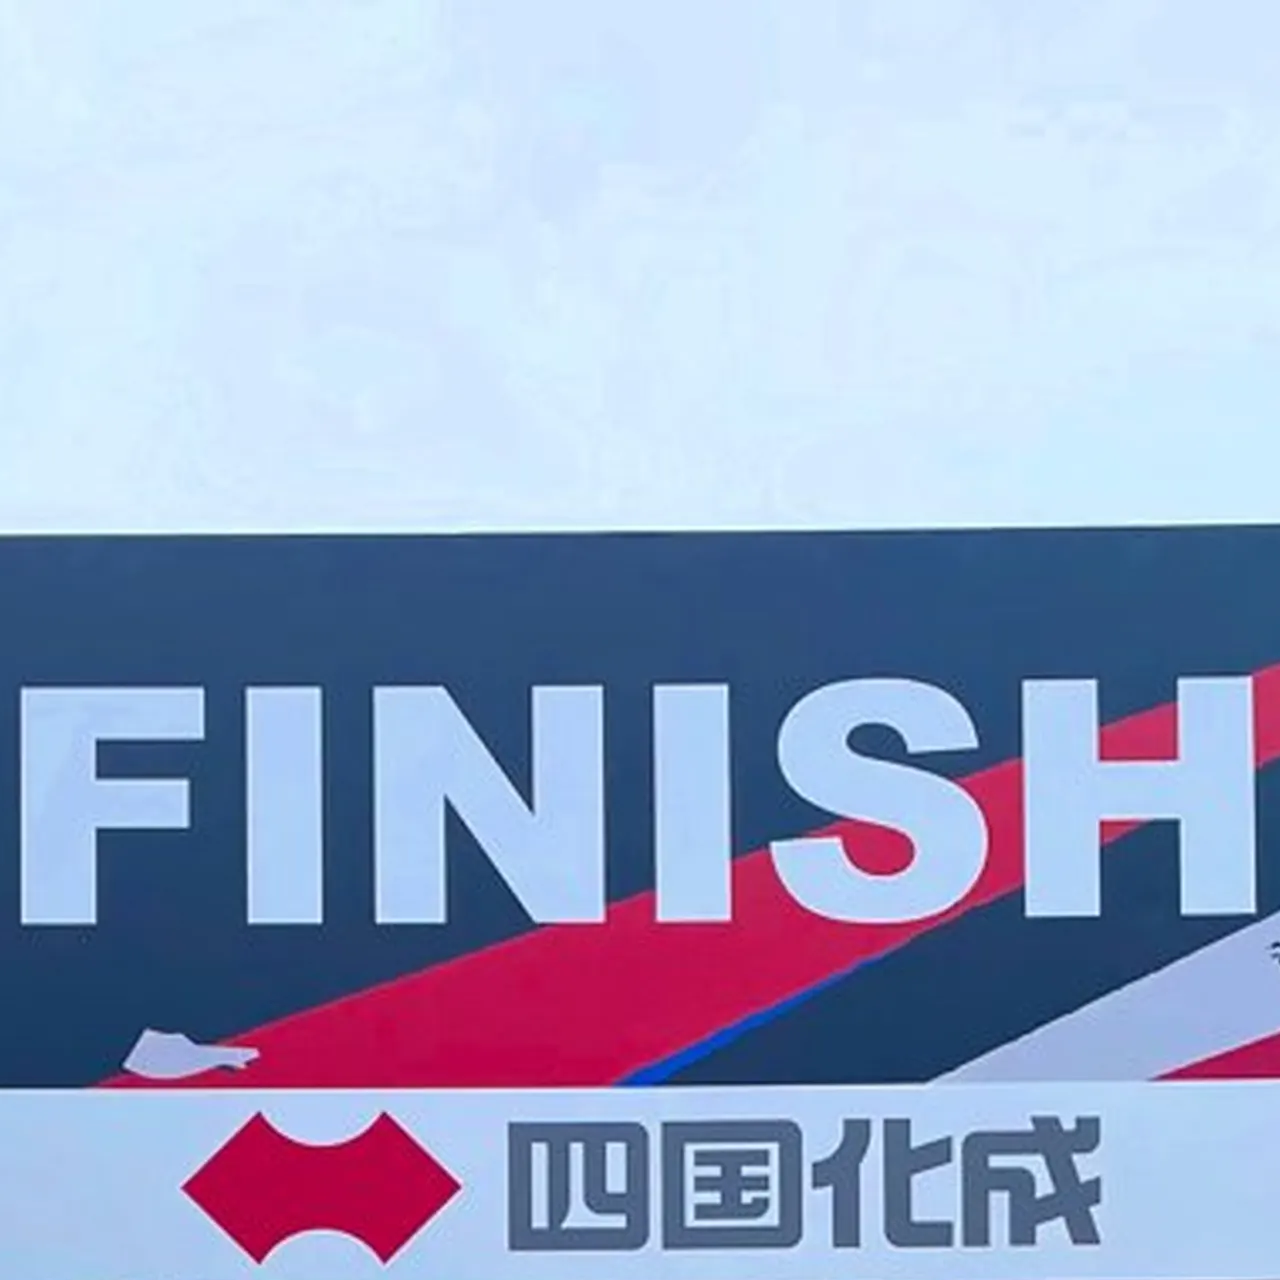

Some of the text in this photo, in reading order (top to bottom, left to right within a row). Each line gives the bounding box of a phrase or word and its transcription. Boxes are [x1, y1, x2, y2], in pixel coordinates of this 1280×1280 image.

[20, 676, 1258, 928] FINISH
[507, 1115, 1103, 1251] 四国化成
